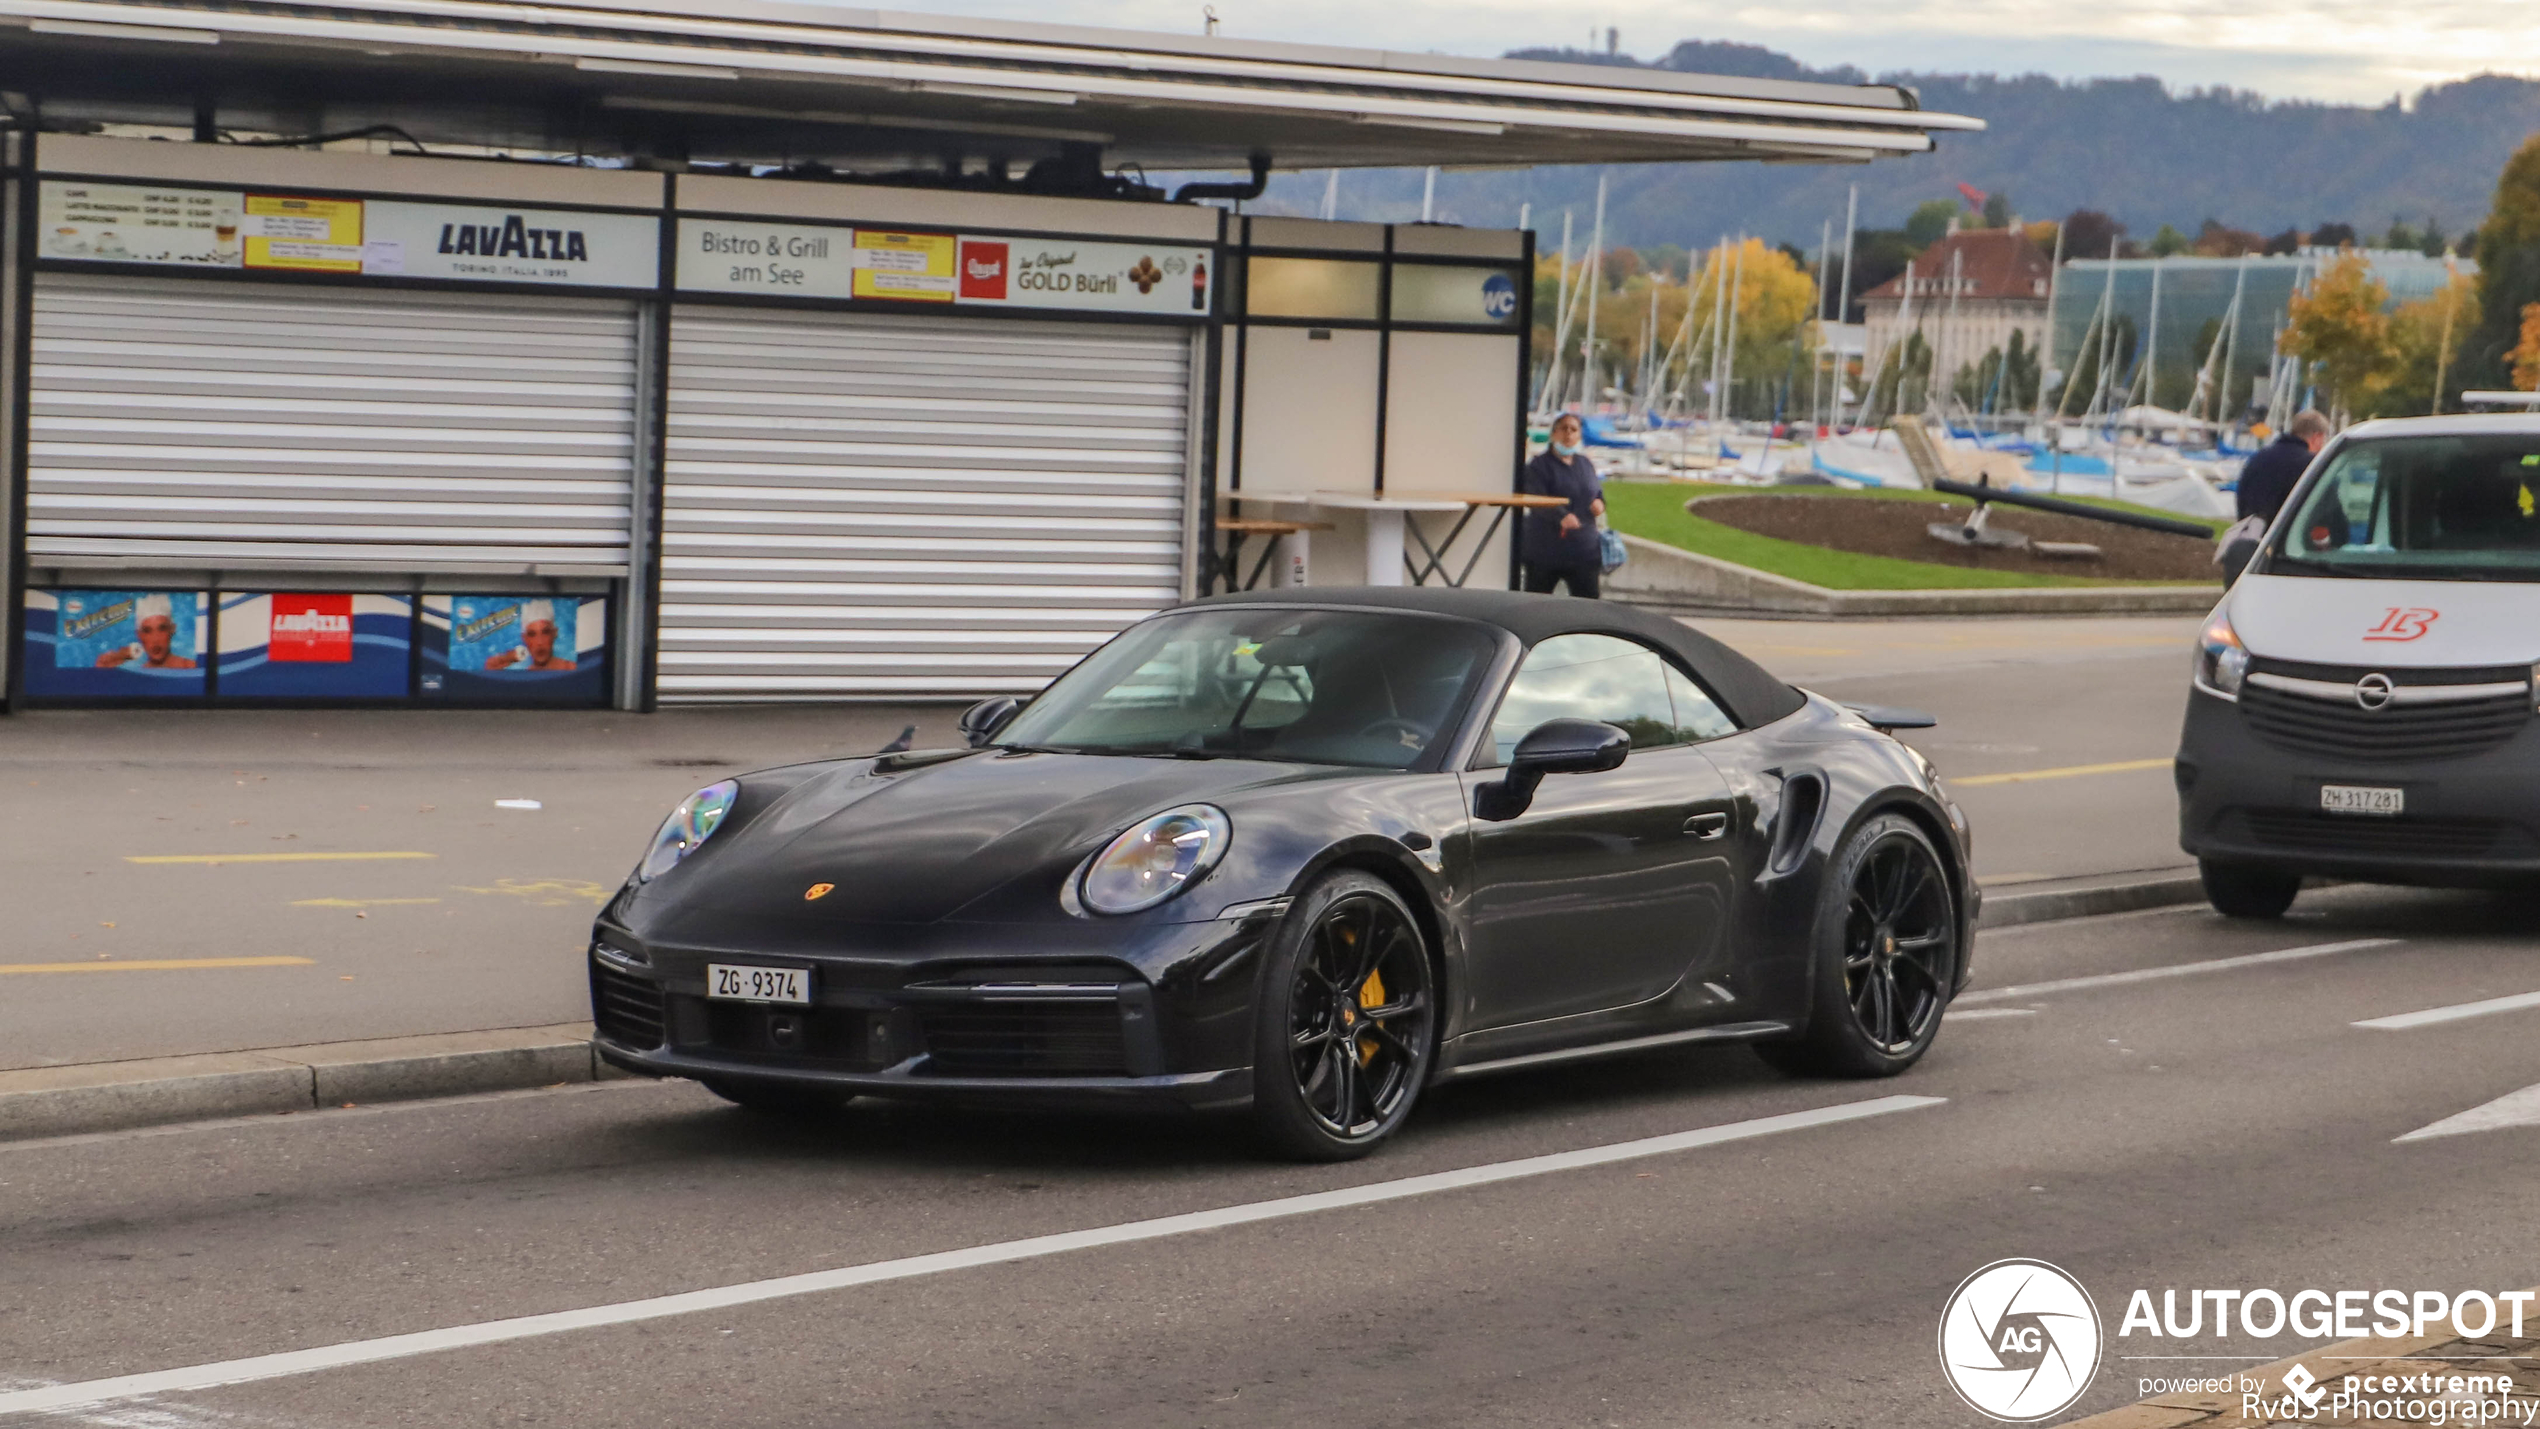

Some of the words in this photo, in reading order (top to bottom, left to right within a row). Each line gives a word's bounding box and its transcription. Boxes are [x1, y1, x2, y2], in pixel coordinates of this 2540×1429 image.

[439, 214, 588, 262] LAVAZZA
[702, 231, 760, 255] Bistro
[766, 235, 782, 256] &
[787, 237, 829, 258] Grill
[730, 265, 762, 282] am
[768, 263, 804, 284] See
[1018, 271, 1071, 291] GOLD
[1484, 291, 1516, 313] WC
[274, 609, 350, 631] LAVAZZA
